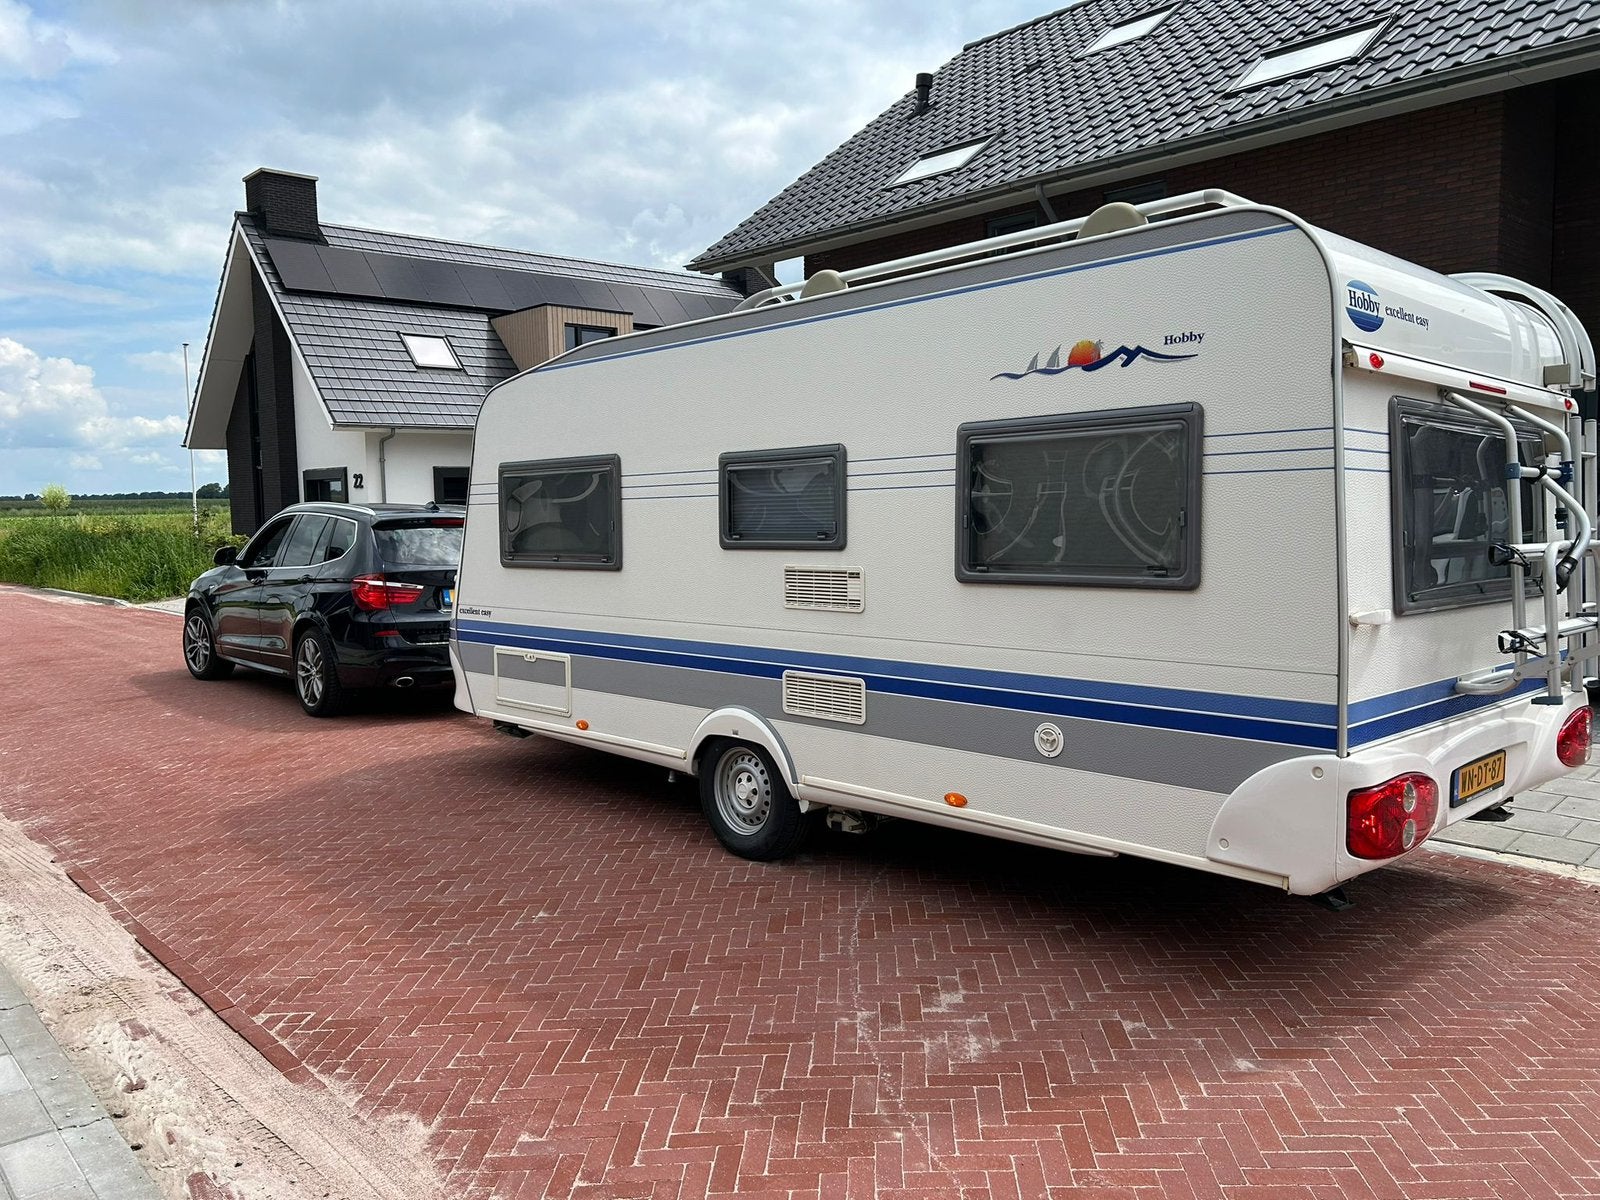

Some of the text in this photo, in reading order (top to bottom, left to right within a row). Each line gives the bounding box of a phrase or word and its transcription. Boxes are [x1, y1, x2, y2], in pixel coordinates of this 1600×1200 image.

[1348, 289, 1381, 319] Hobby
[1384, 305, 1430, 331] excellent easy
[1163, 331, 1205, 346] Hobby
[353, 473, 364, 489] 22
[1461, 756, 1502, 793] WN-DT-87
